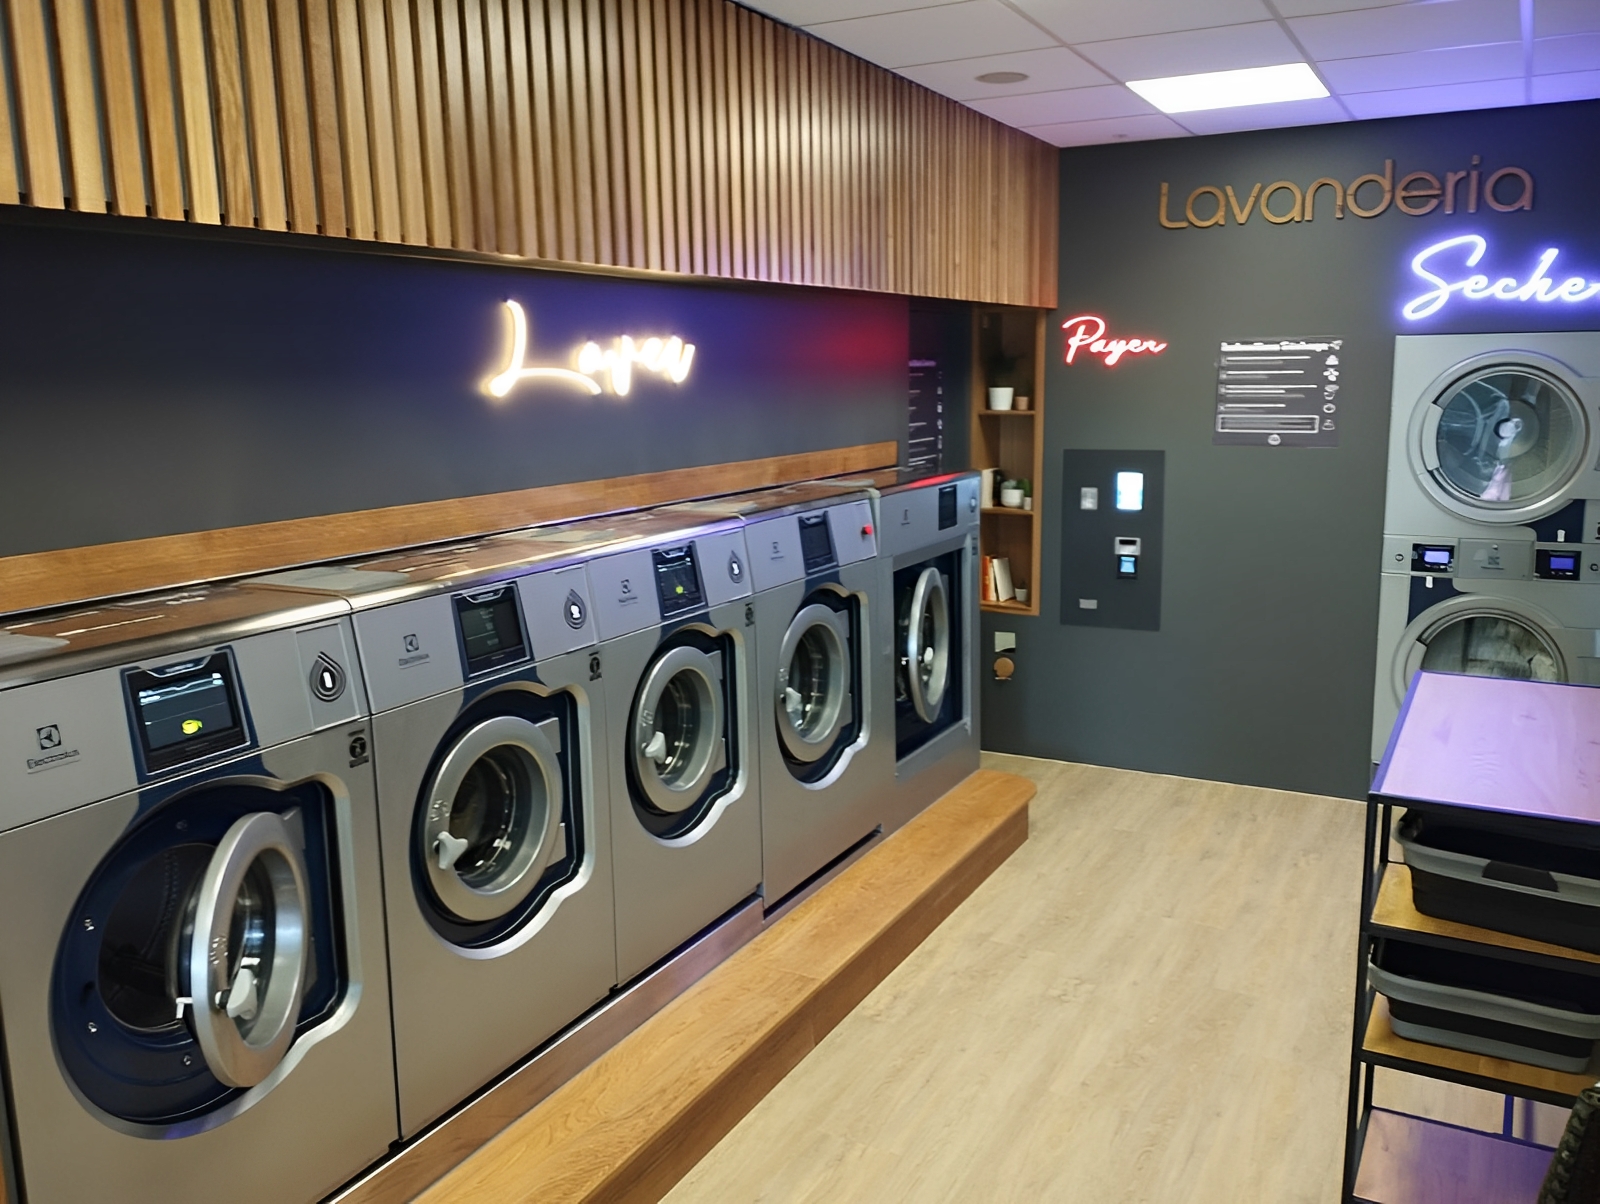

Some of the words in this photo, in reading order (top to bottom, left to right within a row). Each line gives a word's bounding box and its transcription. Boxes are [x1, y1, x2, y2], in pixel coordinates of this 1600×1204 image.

[1158, 155, 1535, 230] Lavanderia
[1401, 233, 1600, 322] Seche
[1061, 315, 1168, 367] Payer
